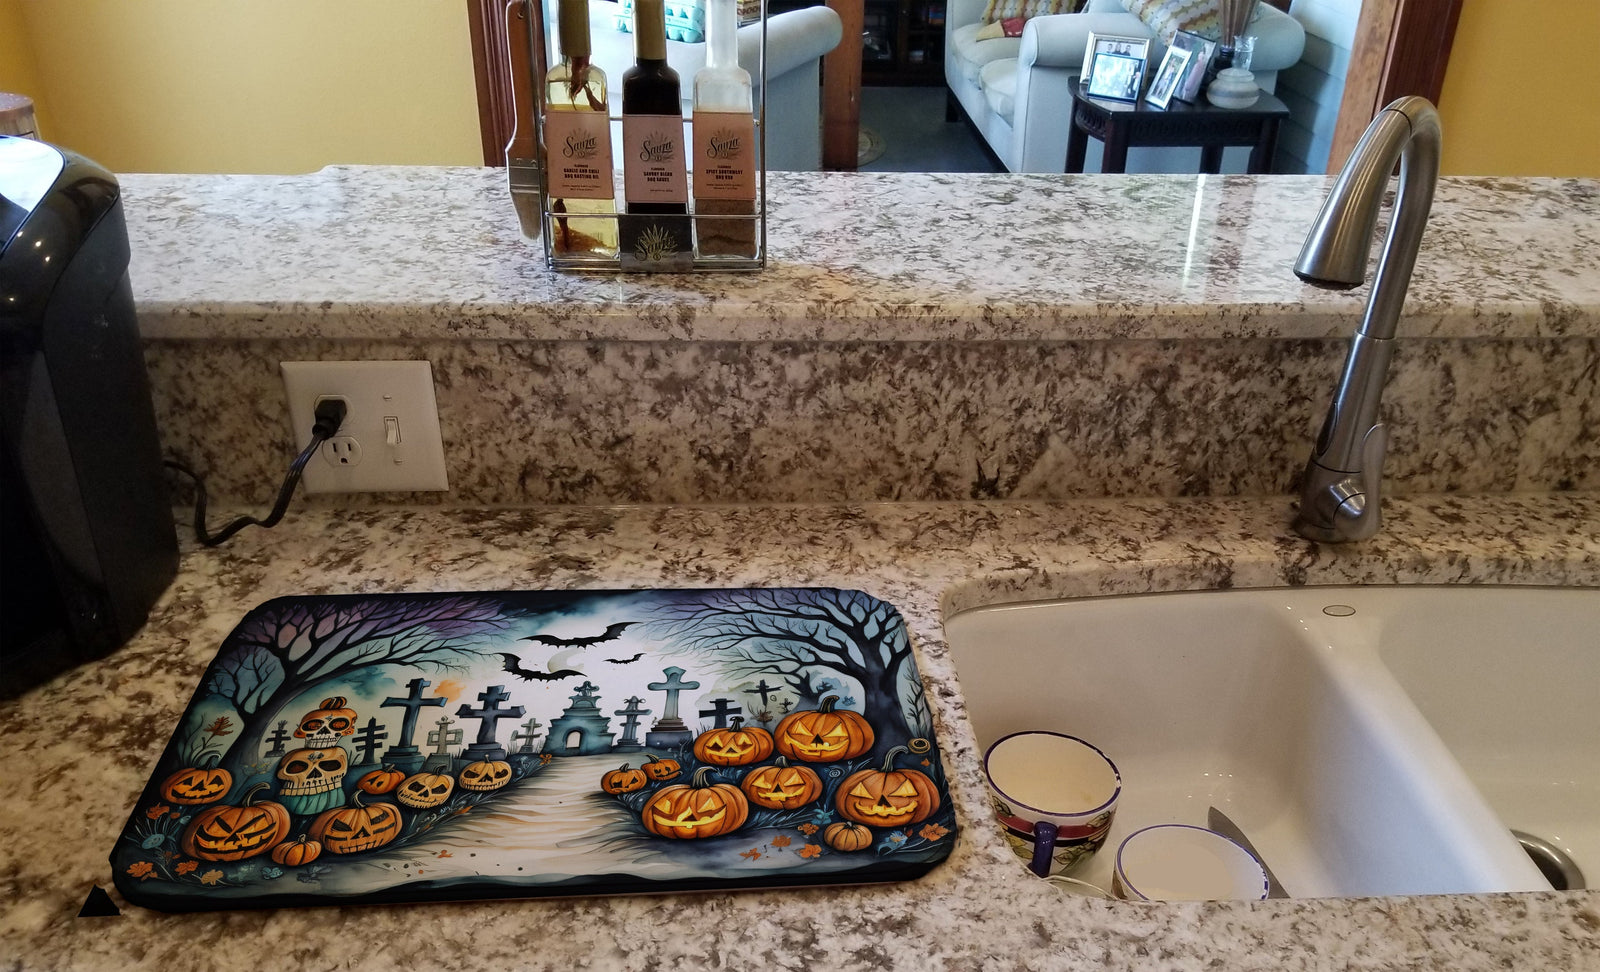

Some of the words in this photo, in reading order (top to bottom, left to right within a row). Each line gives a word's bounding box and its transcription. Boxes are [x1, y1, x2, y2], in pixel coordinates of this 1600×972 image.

[563, 136, 597, 158] Sauza
[640, 140, 673, 161] Sauza
[707, 137, 740, 159] Sauza
